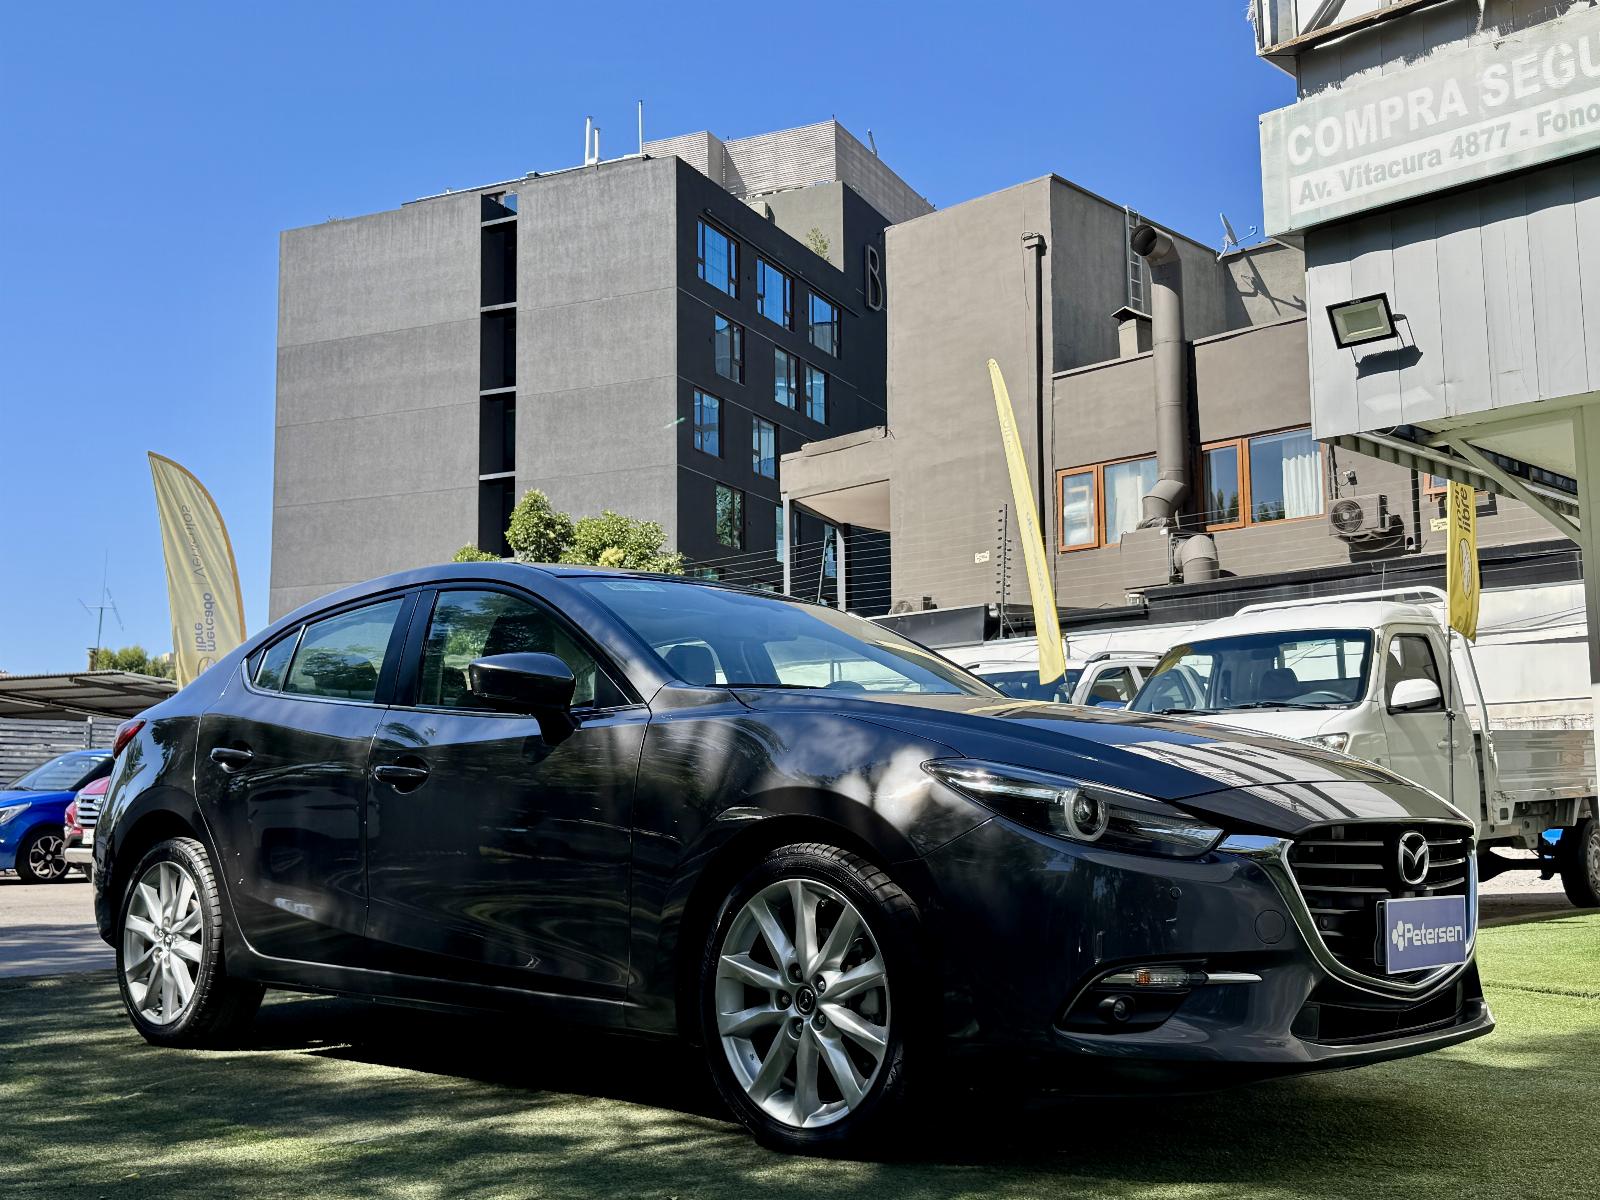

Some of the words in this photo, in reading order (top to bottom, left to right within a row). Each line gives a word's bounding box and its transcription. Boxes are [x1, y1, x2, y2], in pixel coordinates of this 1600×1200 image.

[1287, 78, 1468, 166] COMPRA
[1298, 179, 1332, 205] Av.
[1338, 148, 1441, 192] Vitacura
[1449, 121, 1512, 160] 4877
[1536, 103, 1600, 138] Fono
[864, 244, 883, 311] B
[1460, 487, 1471, 533] libre
[1404, 921, 1463, 947] Petersen
